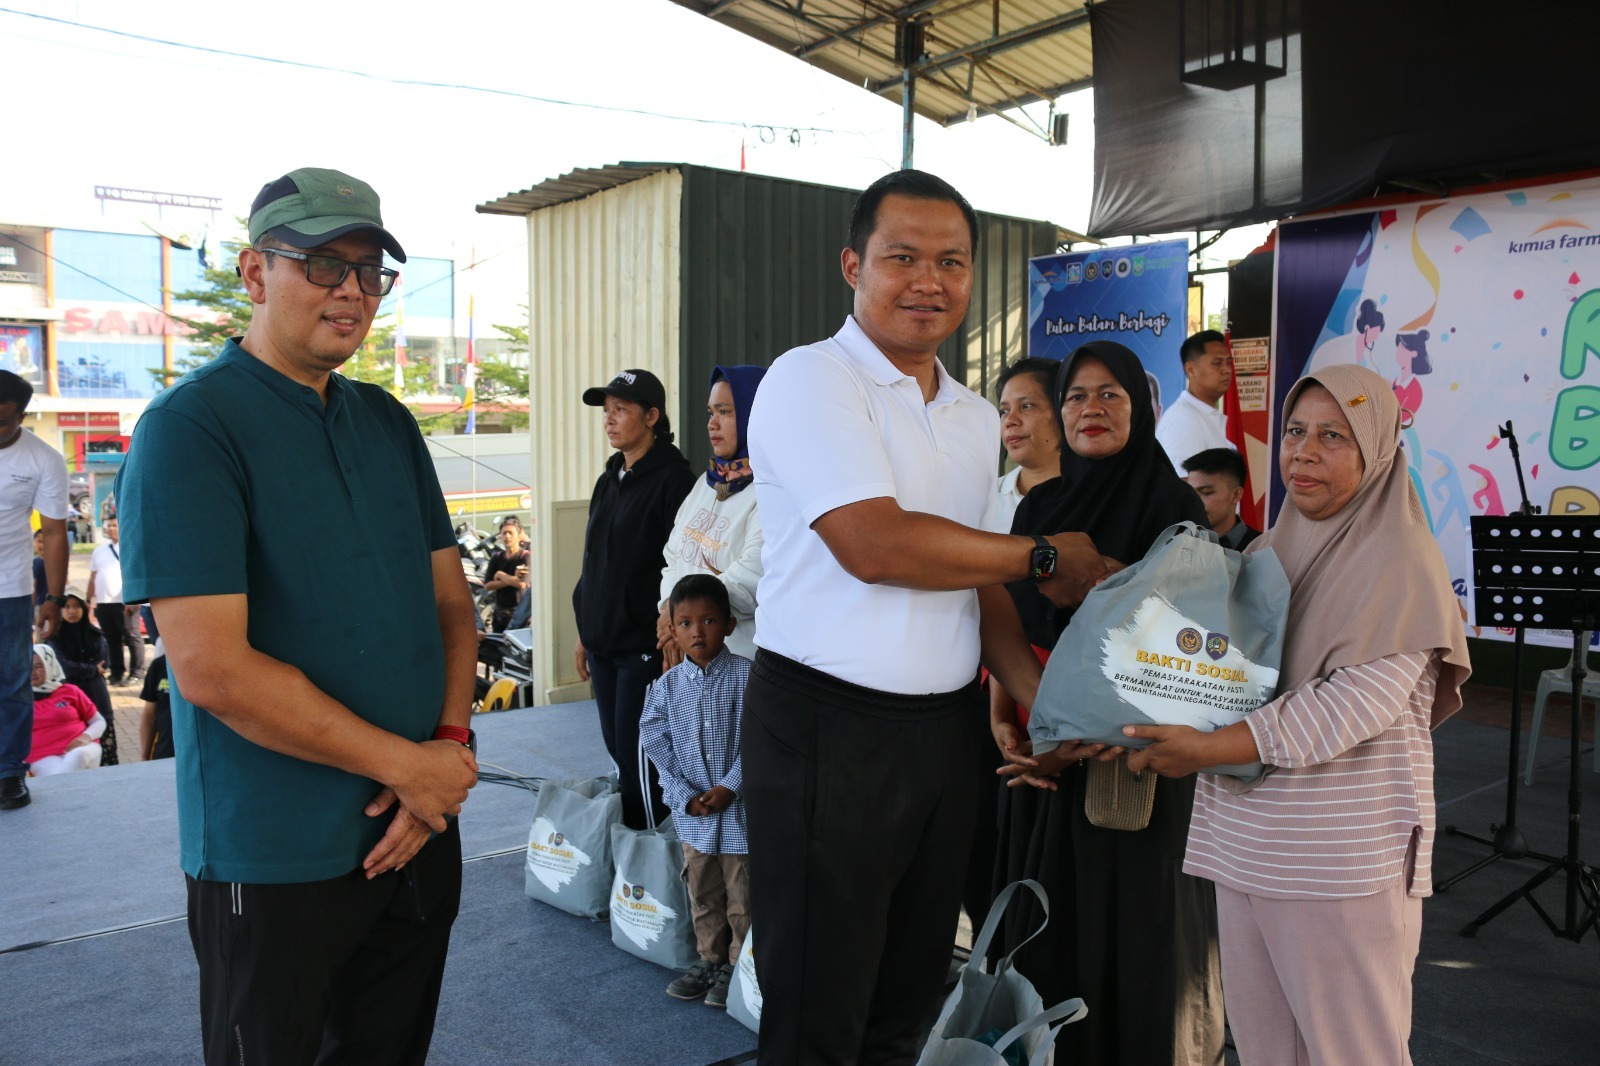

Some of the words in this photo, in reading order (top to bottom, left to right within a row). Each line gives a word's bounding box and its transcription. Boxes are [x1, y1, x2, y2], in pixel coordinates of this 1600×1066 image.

[1045, 318, 1076, 336] Rutan
[1078, 314, 1117, 333] Batam
[1119, 311, 1170, 336] Berbagi
[1136, 649, 1191, 672] BAKTI
[1196, 662, 1248, 682] SOSIAL
[1114, 673, 1173, 691] BERMANFAAT
[1175, 687, 1202, 697] UNTUK
[1122, 683, 1147, 694] RUMAH
[1149, 689, 1182, 701] TAHANAN
[1184, 696, 1212, 706] NEGARA
[1214, 702, 1233, 711] KELAS
[549, 847, 575, 859] SOSIAL
[630, 902, 657, 913] SOSIAL
